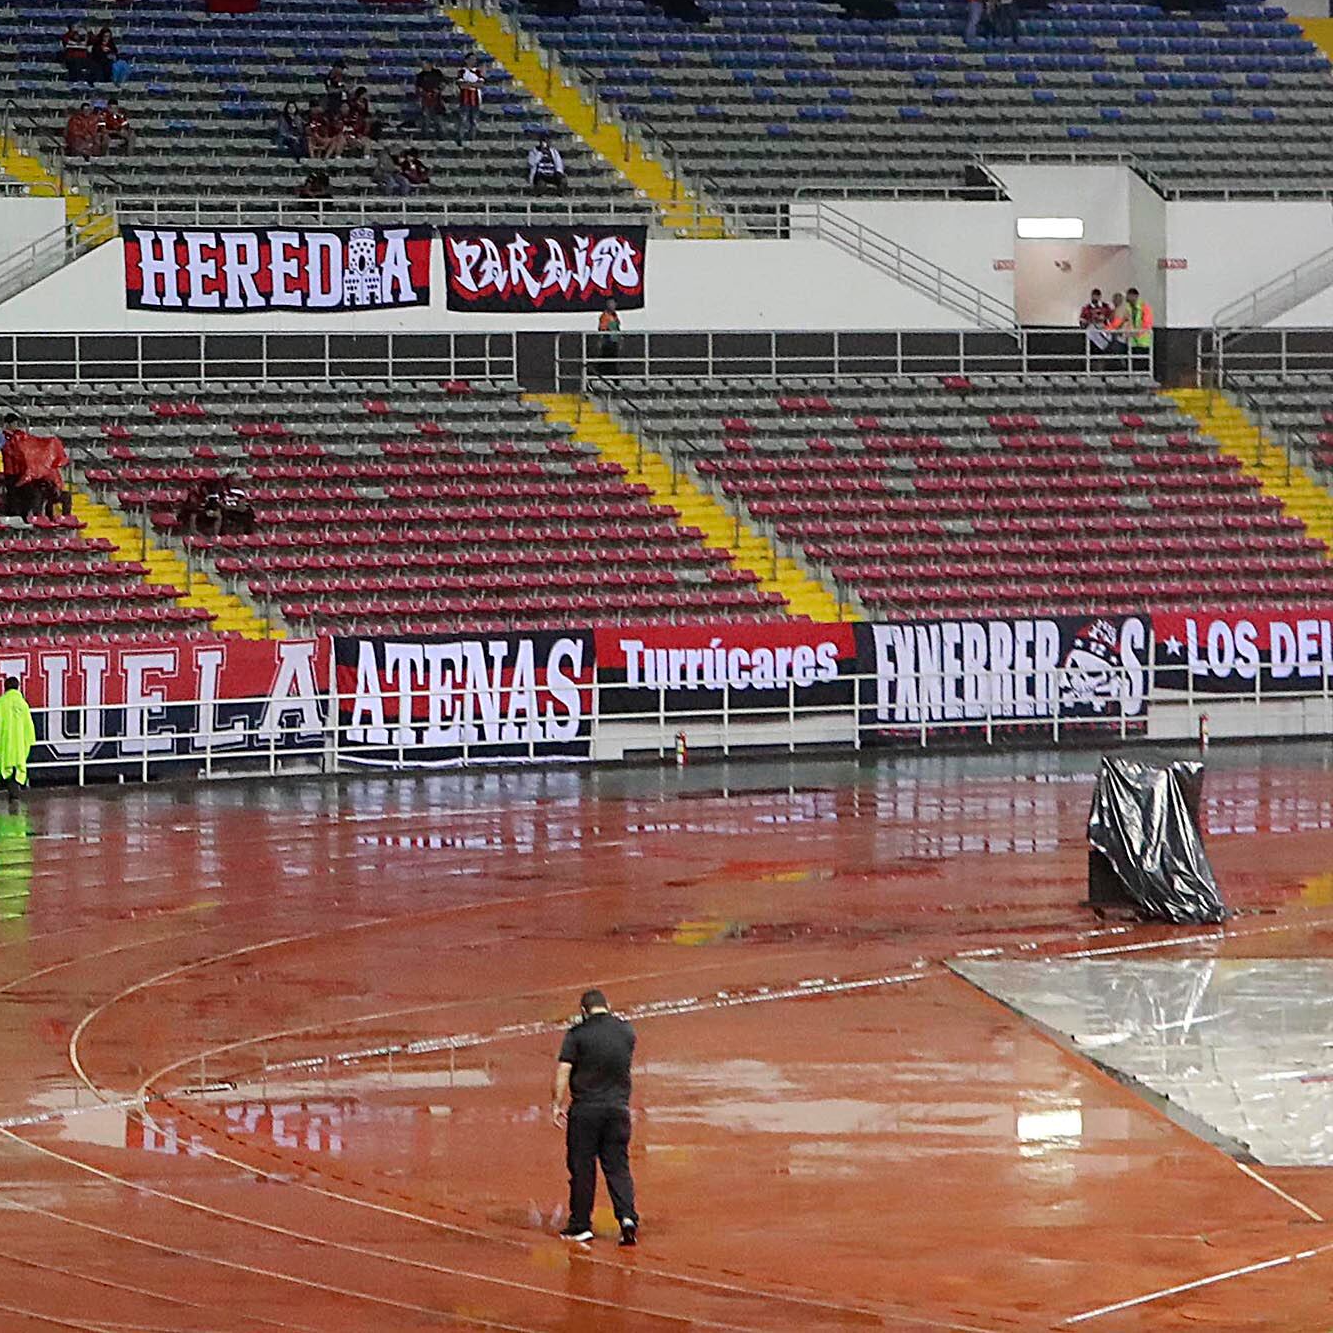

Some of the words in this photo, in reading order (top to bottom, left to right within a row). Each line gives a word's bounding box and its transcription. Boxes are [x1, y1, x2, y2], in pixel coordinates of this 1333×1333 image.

[620, 638, 840, 690] Turrúcares
[1186, 618, 1259, 679] LOS
[345, 638, 584, 745] ATENAS
